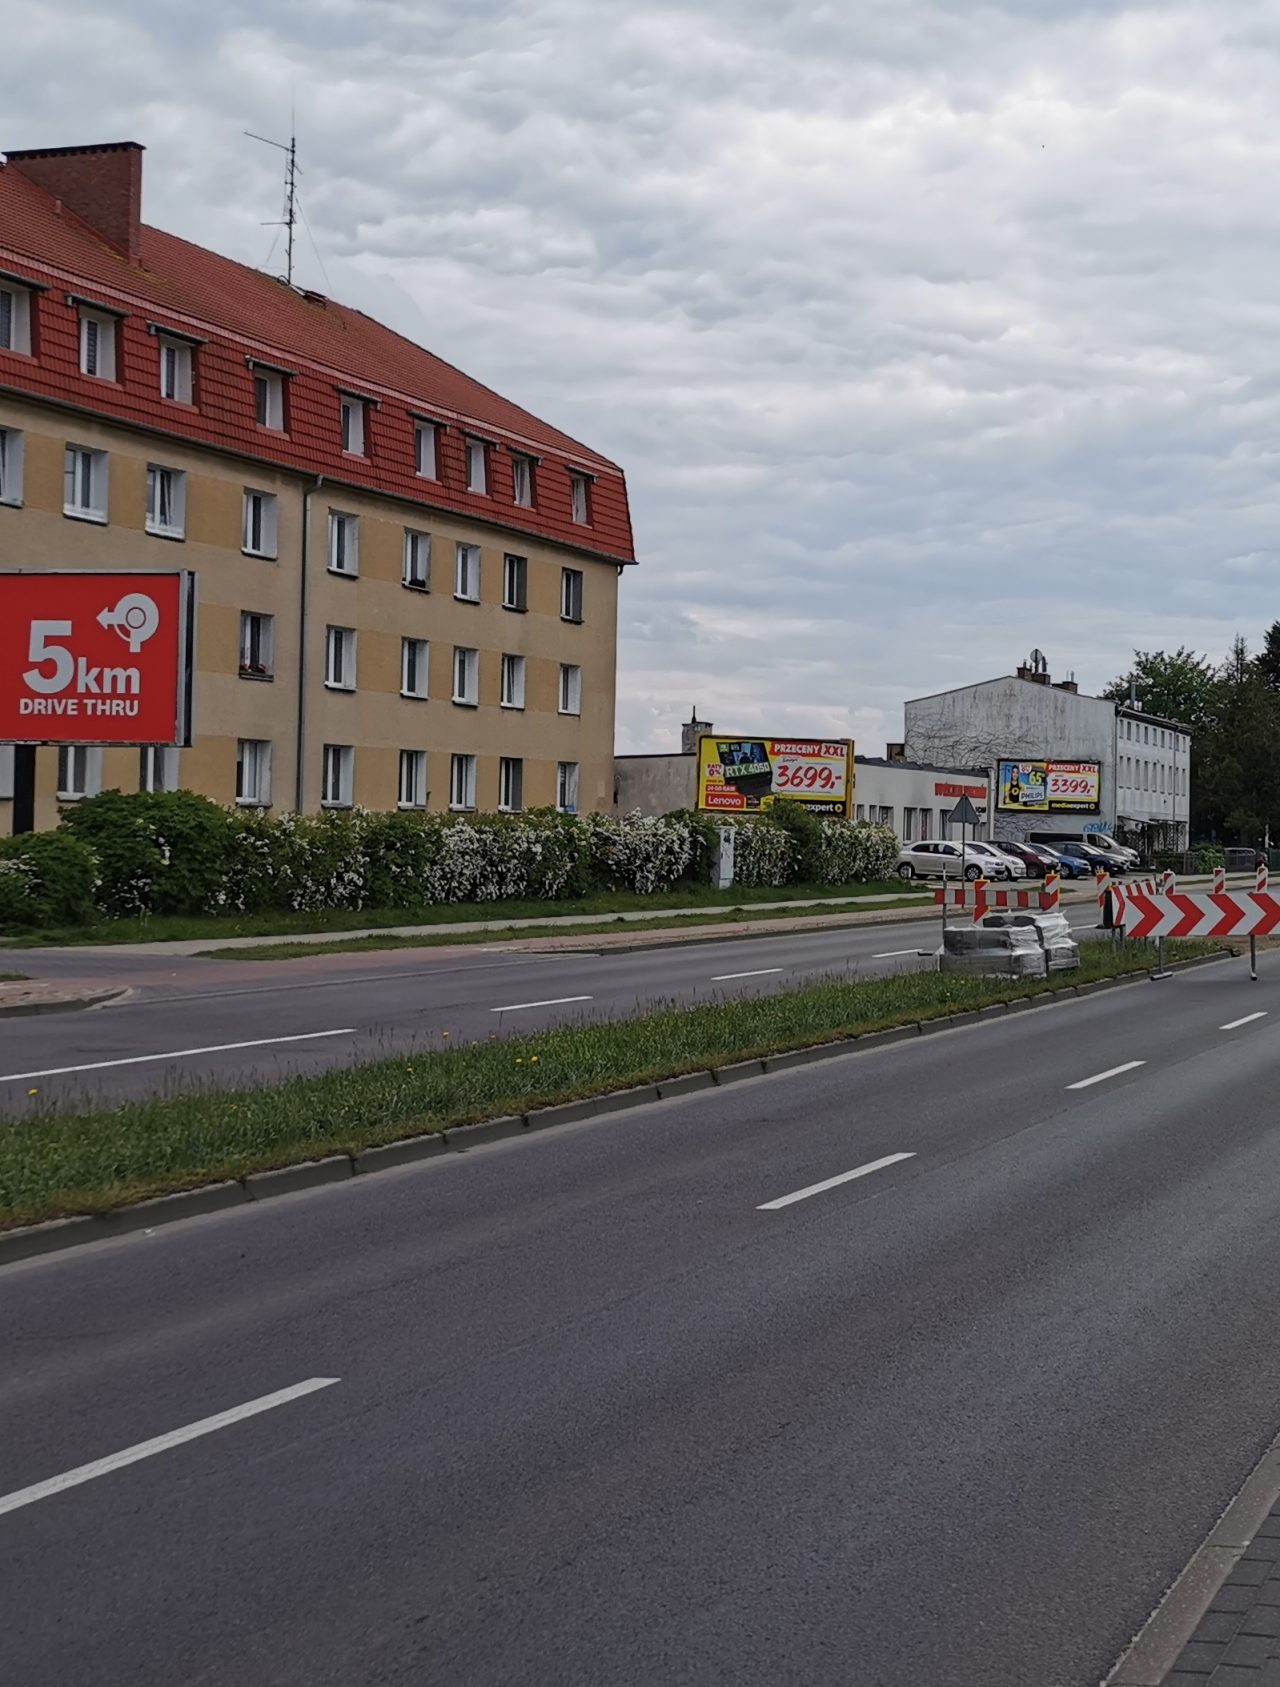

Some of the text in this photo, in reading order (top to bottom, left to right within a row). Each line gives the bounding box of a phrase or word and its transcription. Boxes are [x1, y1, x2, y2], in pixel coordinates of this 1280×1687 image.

[19, 698, 138, 716] DRIVE THRU
[774, 743, 845, 757] PRZECENY XXL
[725, 762, 769, 777] RTX 4050
[708, 796, 741, 805] Lenovo
